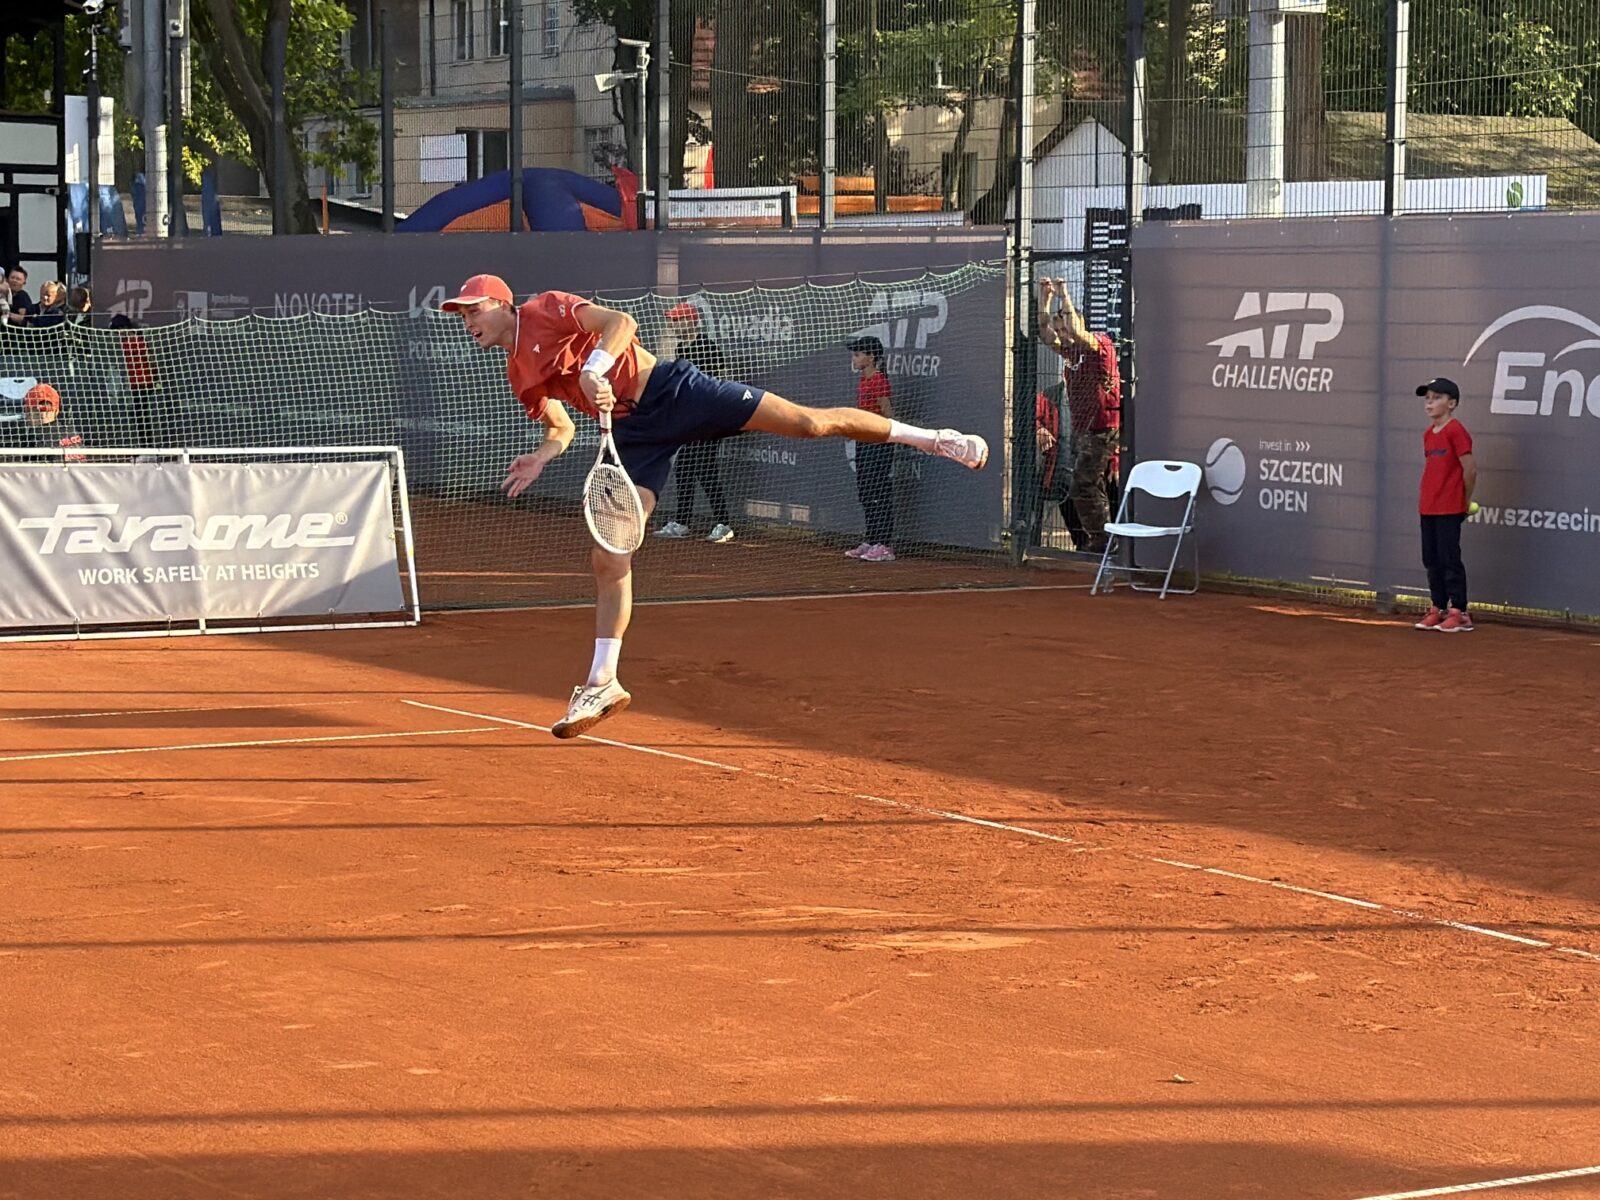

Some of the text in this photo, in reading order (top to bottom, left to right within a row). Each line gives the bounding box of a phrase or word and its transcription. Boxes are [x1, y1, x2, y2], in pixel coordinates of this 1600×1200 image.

[106, 279, 153, 319] ATP
[847, 290, 948, 349] ATP
[1206, 292, 1345, 360] ATP
[1212, 364, 1334, 392] CHALLENGER
[1260, 458, 1343, 486] SZCZECIN
[1259, 488, 1308, 513] OPEN
[78, 563, 320, 585] WORK SAFELY AT HEIGHTS
